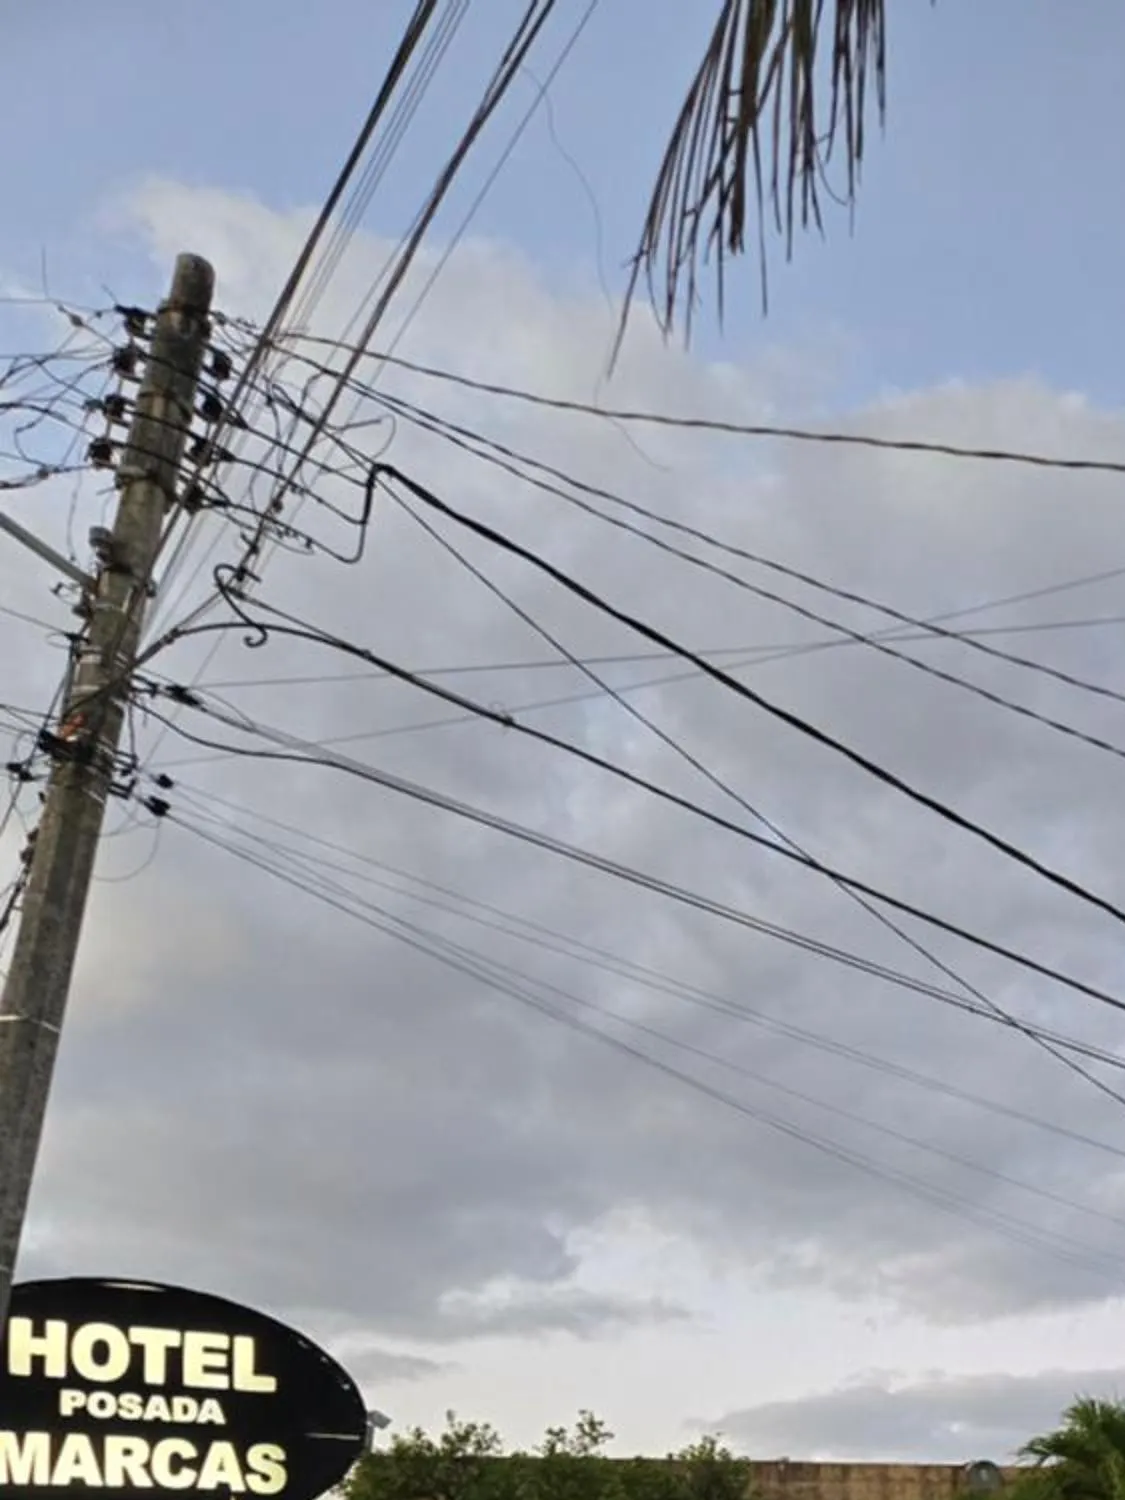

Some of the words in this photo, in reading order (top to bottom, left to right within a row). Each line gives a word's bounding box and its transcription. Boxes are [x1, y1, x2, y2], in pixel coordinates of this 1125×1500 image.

[8, 1316, 277, 1393] HOTEL
[59, 1388, 226, 1425] POSADA
[0, 1430, 287, 1495] MARCAS
